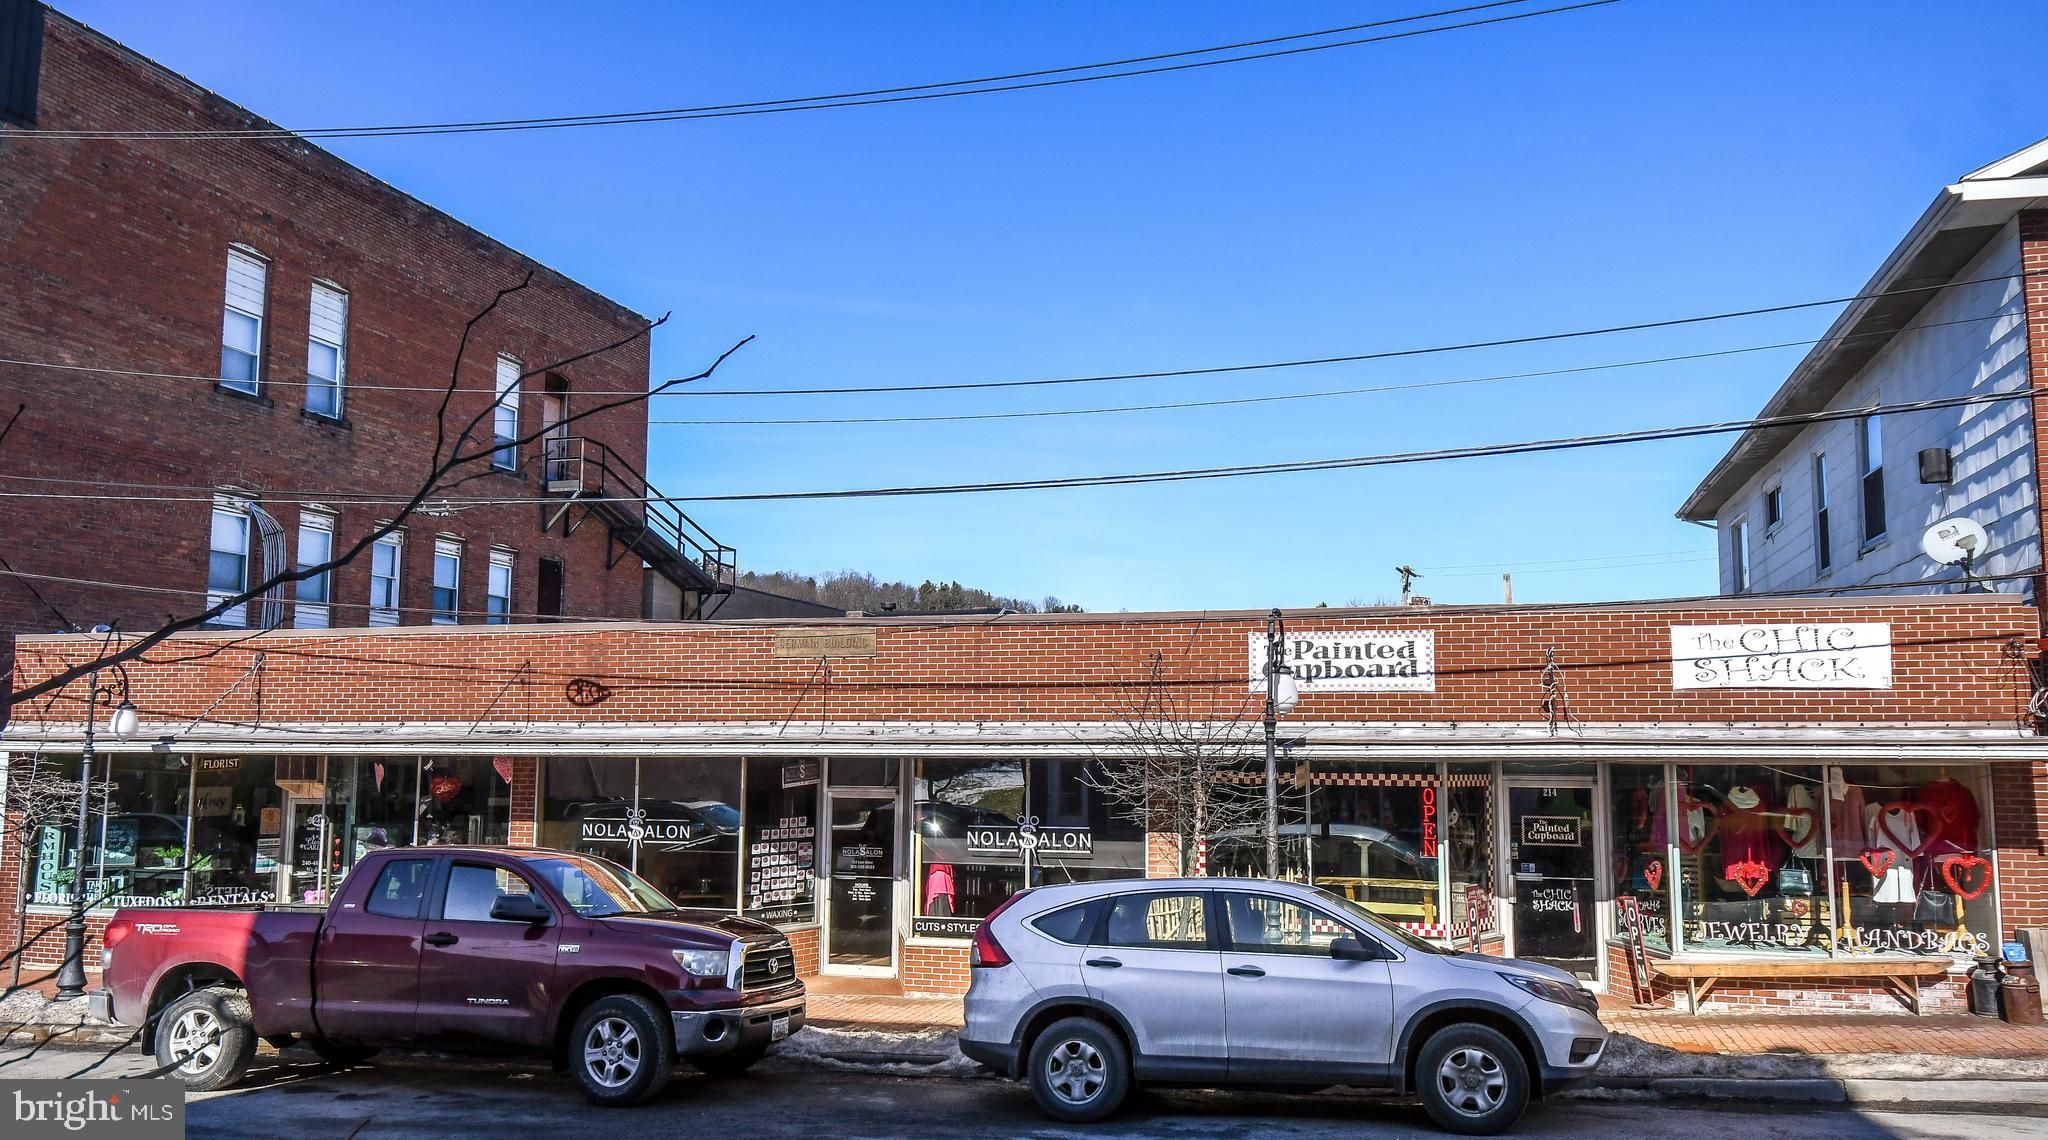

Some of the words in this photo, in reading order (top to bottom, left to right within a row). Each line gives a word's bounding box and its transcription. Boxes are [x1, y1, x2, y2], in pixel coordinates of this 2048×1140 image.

[824, 636, 868, 649] BUILDING
[1691, 632, 1735, 651] The
[1740, 626, 1857, 657] CHIC
[1293, 640, 1417, 661] Painted
[1262, 659, 1420, 683] upboard
[1694, 656, 1866, 686] SHACK
[203, 758, 240, 769] FLORIST
[1542, 788, 1557, 797] 214
[1422, 787, 1438, 858] OPEN
[1533, 823, 1570, 833] Painted
[1528, 831, 1575, 842] Cupboard
[33, 892, 86, 905] FLORI
[196, 890, 269, 906] RENTALS
[1531, 889, 1543, 898] The
[1543, 888, 1572, 900] CHIC
[112, 895, 172, 908] TUXEDOS
[1533, 899, 1575, 911] SHACK
[765, 909, 794, 919] WAXING
[915, 922, 940, 932] CUTS
[1618, 907, 1667, 936] SCRVES
[135, 923, 162, 934] TRD
[1469, 907, 1479, 953] OPE
[1695, 921, 1812, 943] JEWELRY
[1628, 906, 1647, 980] OPEN
[1838, 927, 1991, 952] HANDBAGS
[467, 997, 510, 1005] TUNDRA
